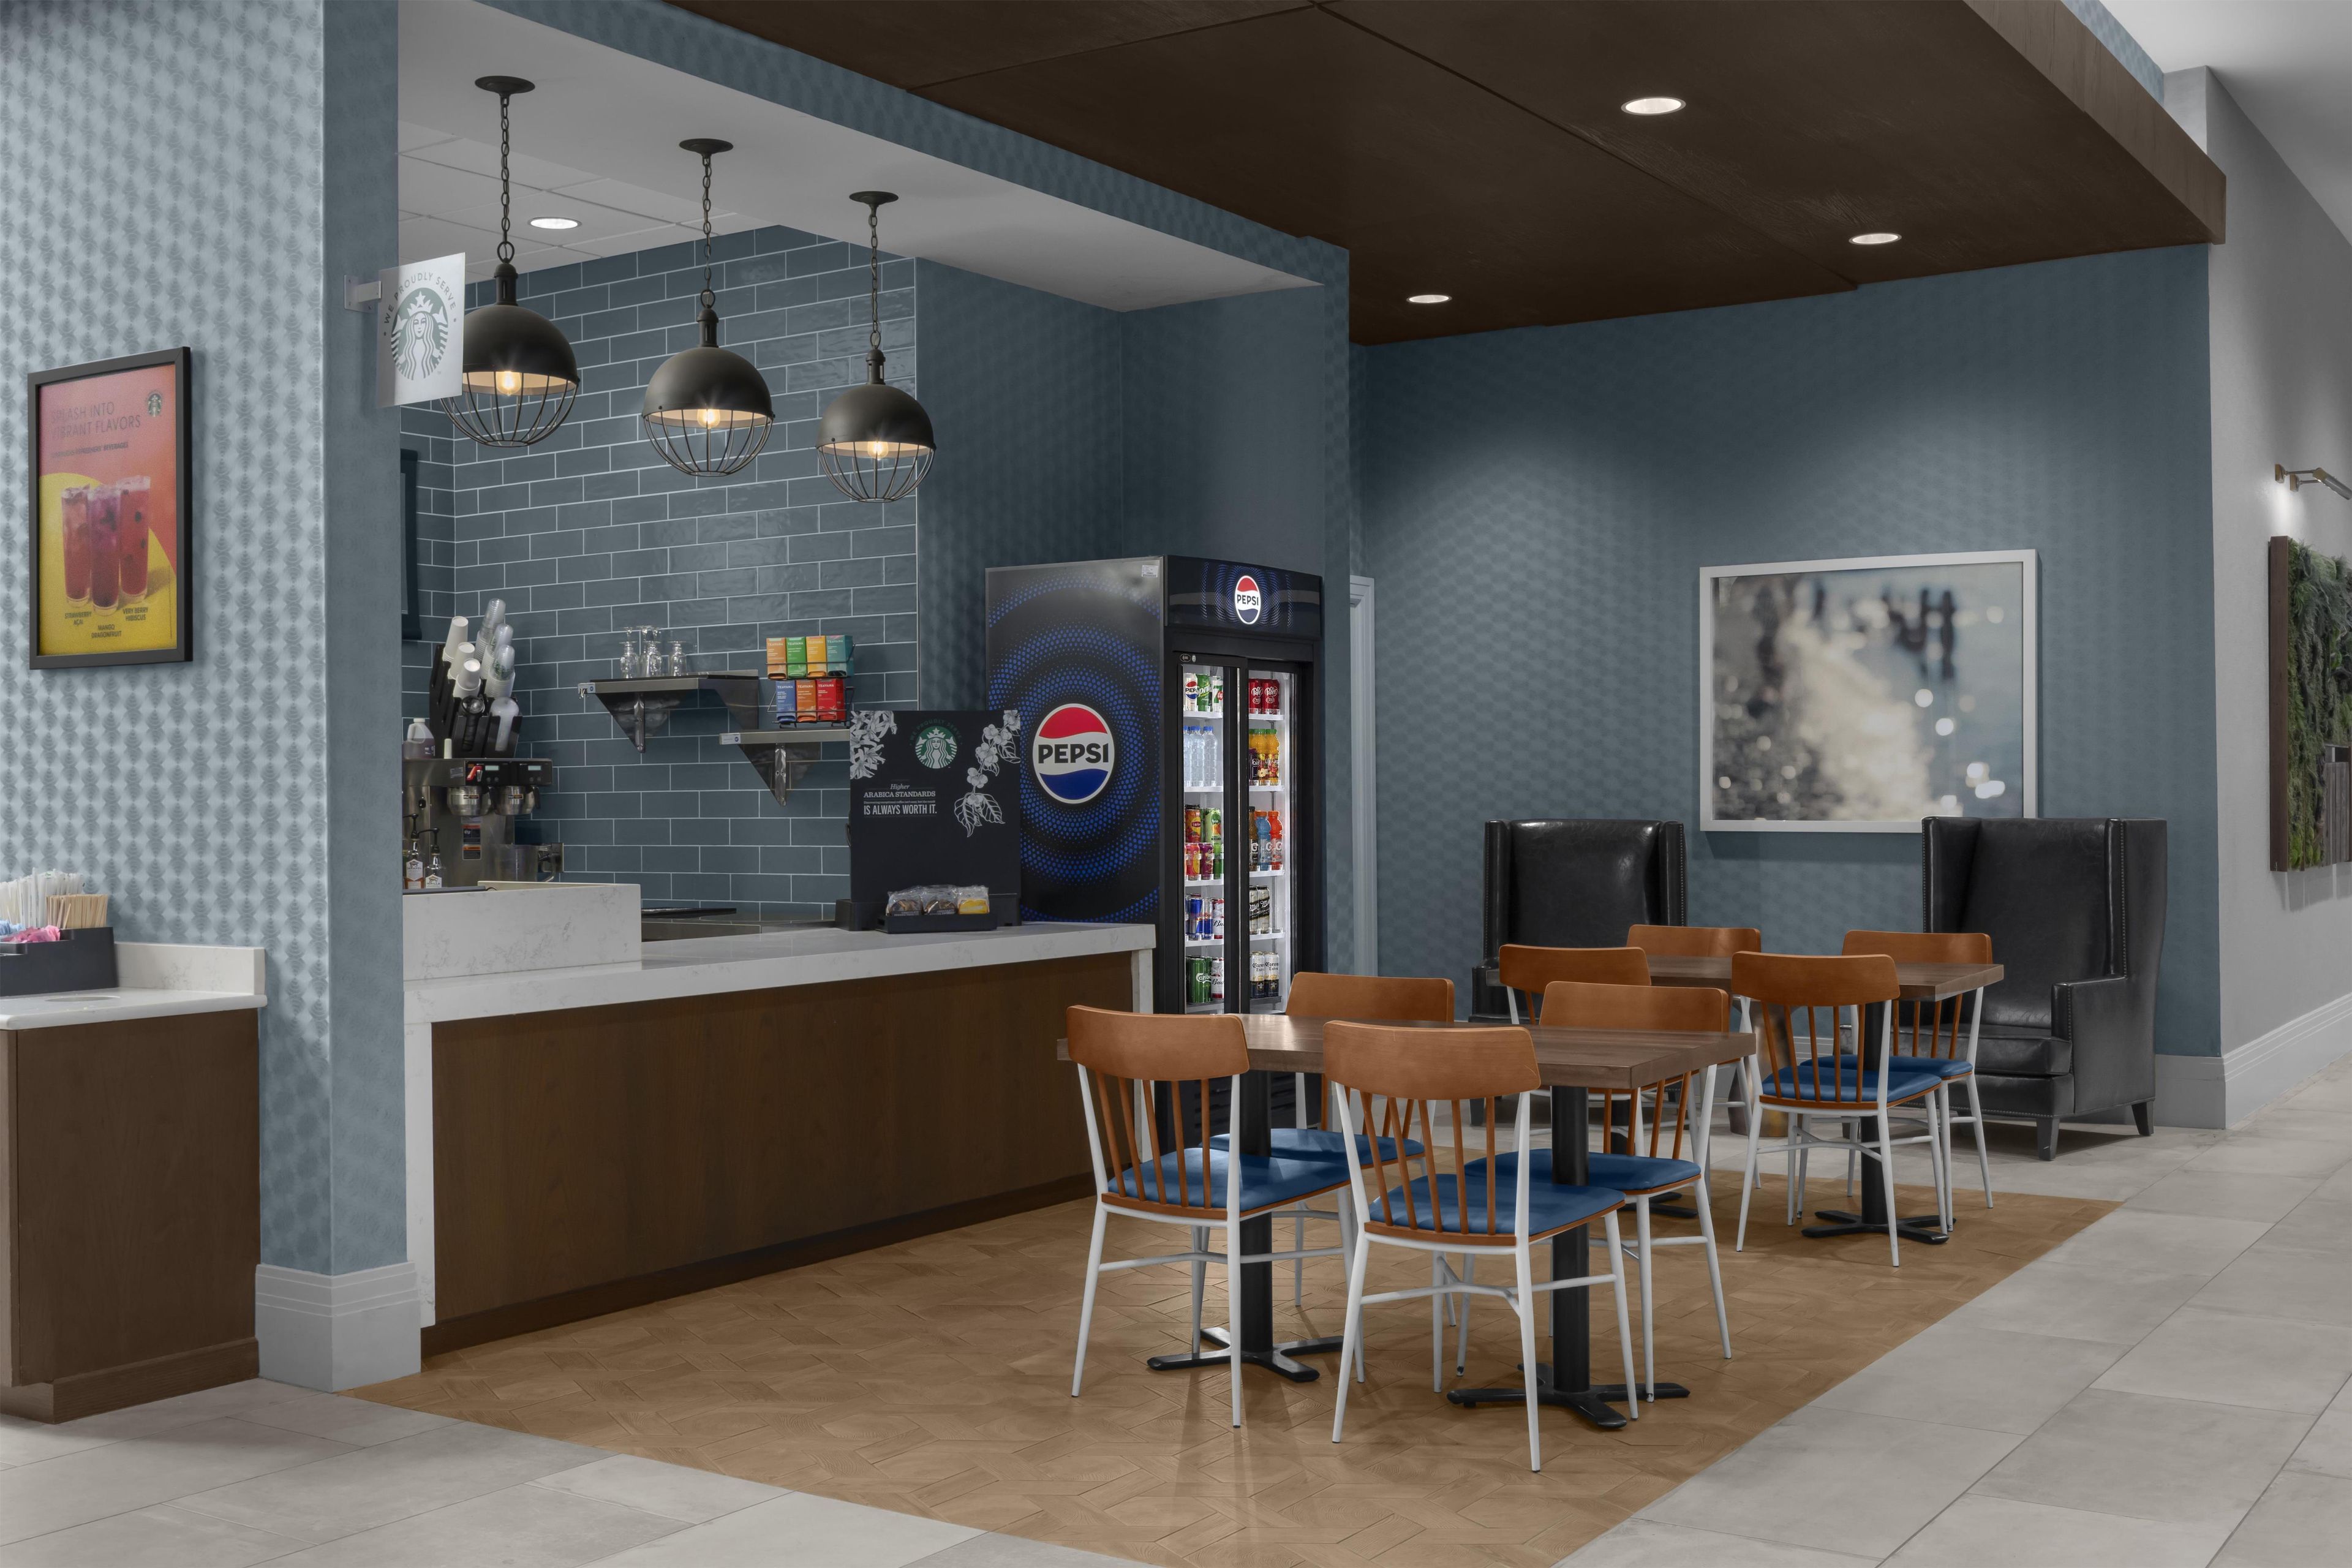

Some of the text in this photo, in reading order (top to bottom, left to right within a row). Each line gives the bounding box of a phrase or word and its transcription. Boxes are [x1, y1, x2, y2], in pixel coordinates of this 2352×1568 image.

[384, 271, 456, 324] WE PROUDLY SERVE
[51, 401, 115, 424] SPLASH INTO
[96, 414, 141, 433] FLAVORS
[103, 442, 129, 451] BEVERAGES
[1237, 594, 1259, 606] PEPSI
[64, 611, 92, 619] STRAWBERRY
[1038, 743, 1109, 764] PEPSI
[864, 805, 870, 815] IS
[872, 804, 900, 815] ALWAYS
[902, 804, 927, 814] WORTH
[1252, 842, 1257, 852] G
[1265, 842, 1272, 851] G
[1275, 841, 1281, 851] G
